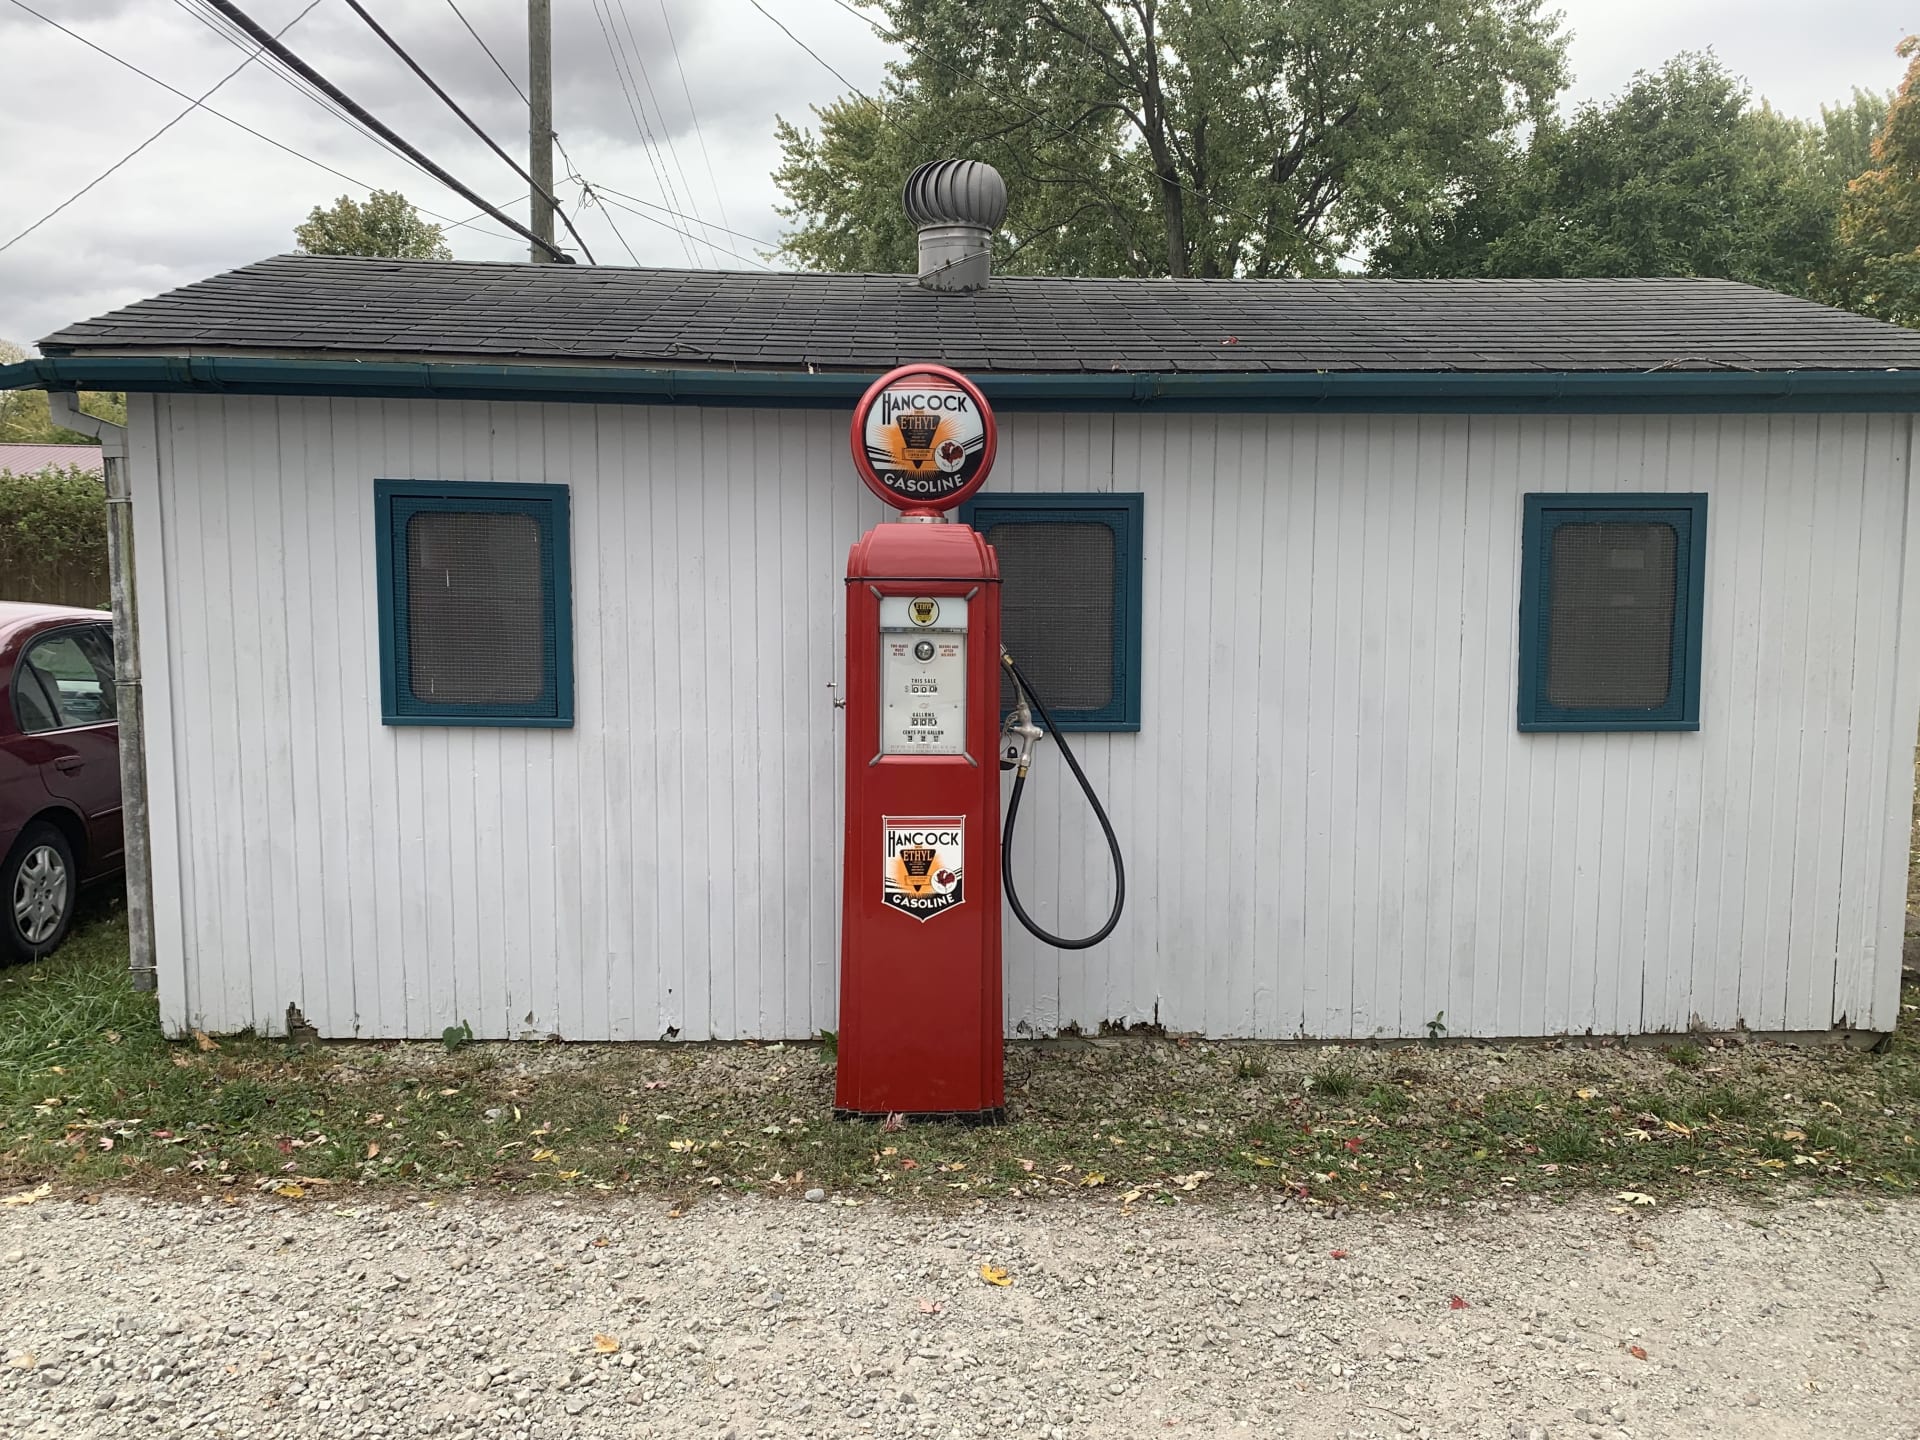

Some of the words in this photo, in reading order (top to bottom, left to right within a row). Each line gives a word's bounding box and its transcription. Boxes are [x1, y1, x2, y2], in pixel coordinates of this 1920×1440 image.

[882, 393, 968, 425] HANCOCK
[900, 416, 936, 430] ETHYL
[883, 473, 964, 493] GASOLINE
[888, 831, 959, 857] HANCOCK
[903, 850, 933, 861] ETHYL
[892, 894, 955, 908] GASOLINE
